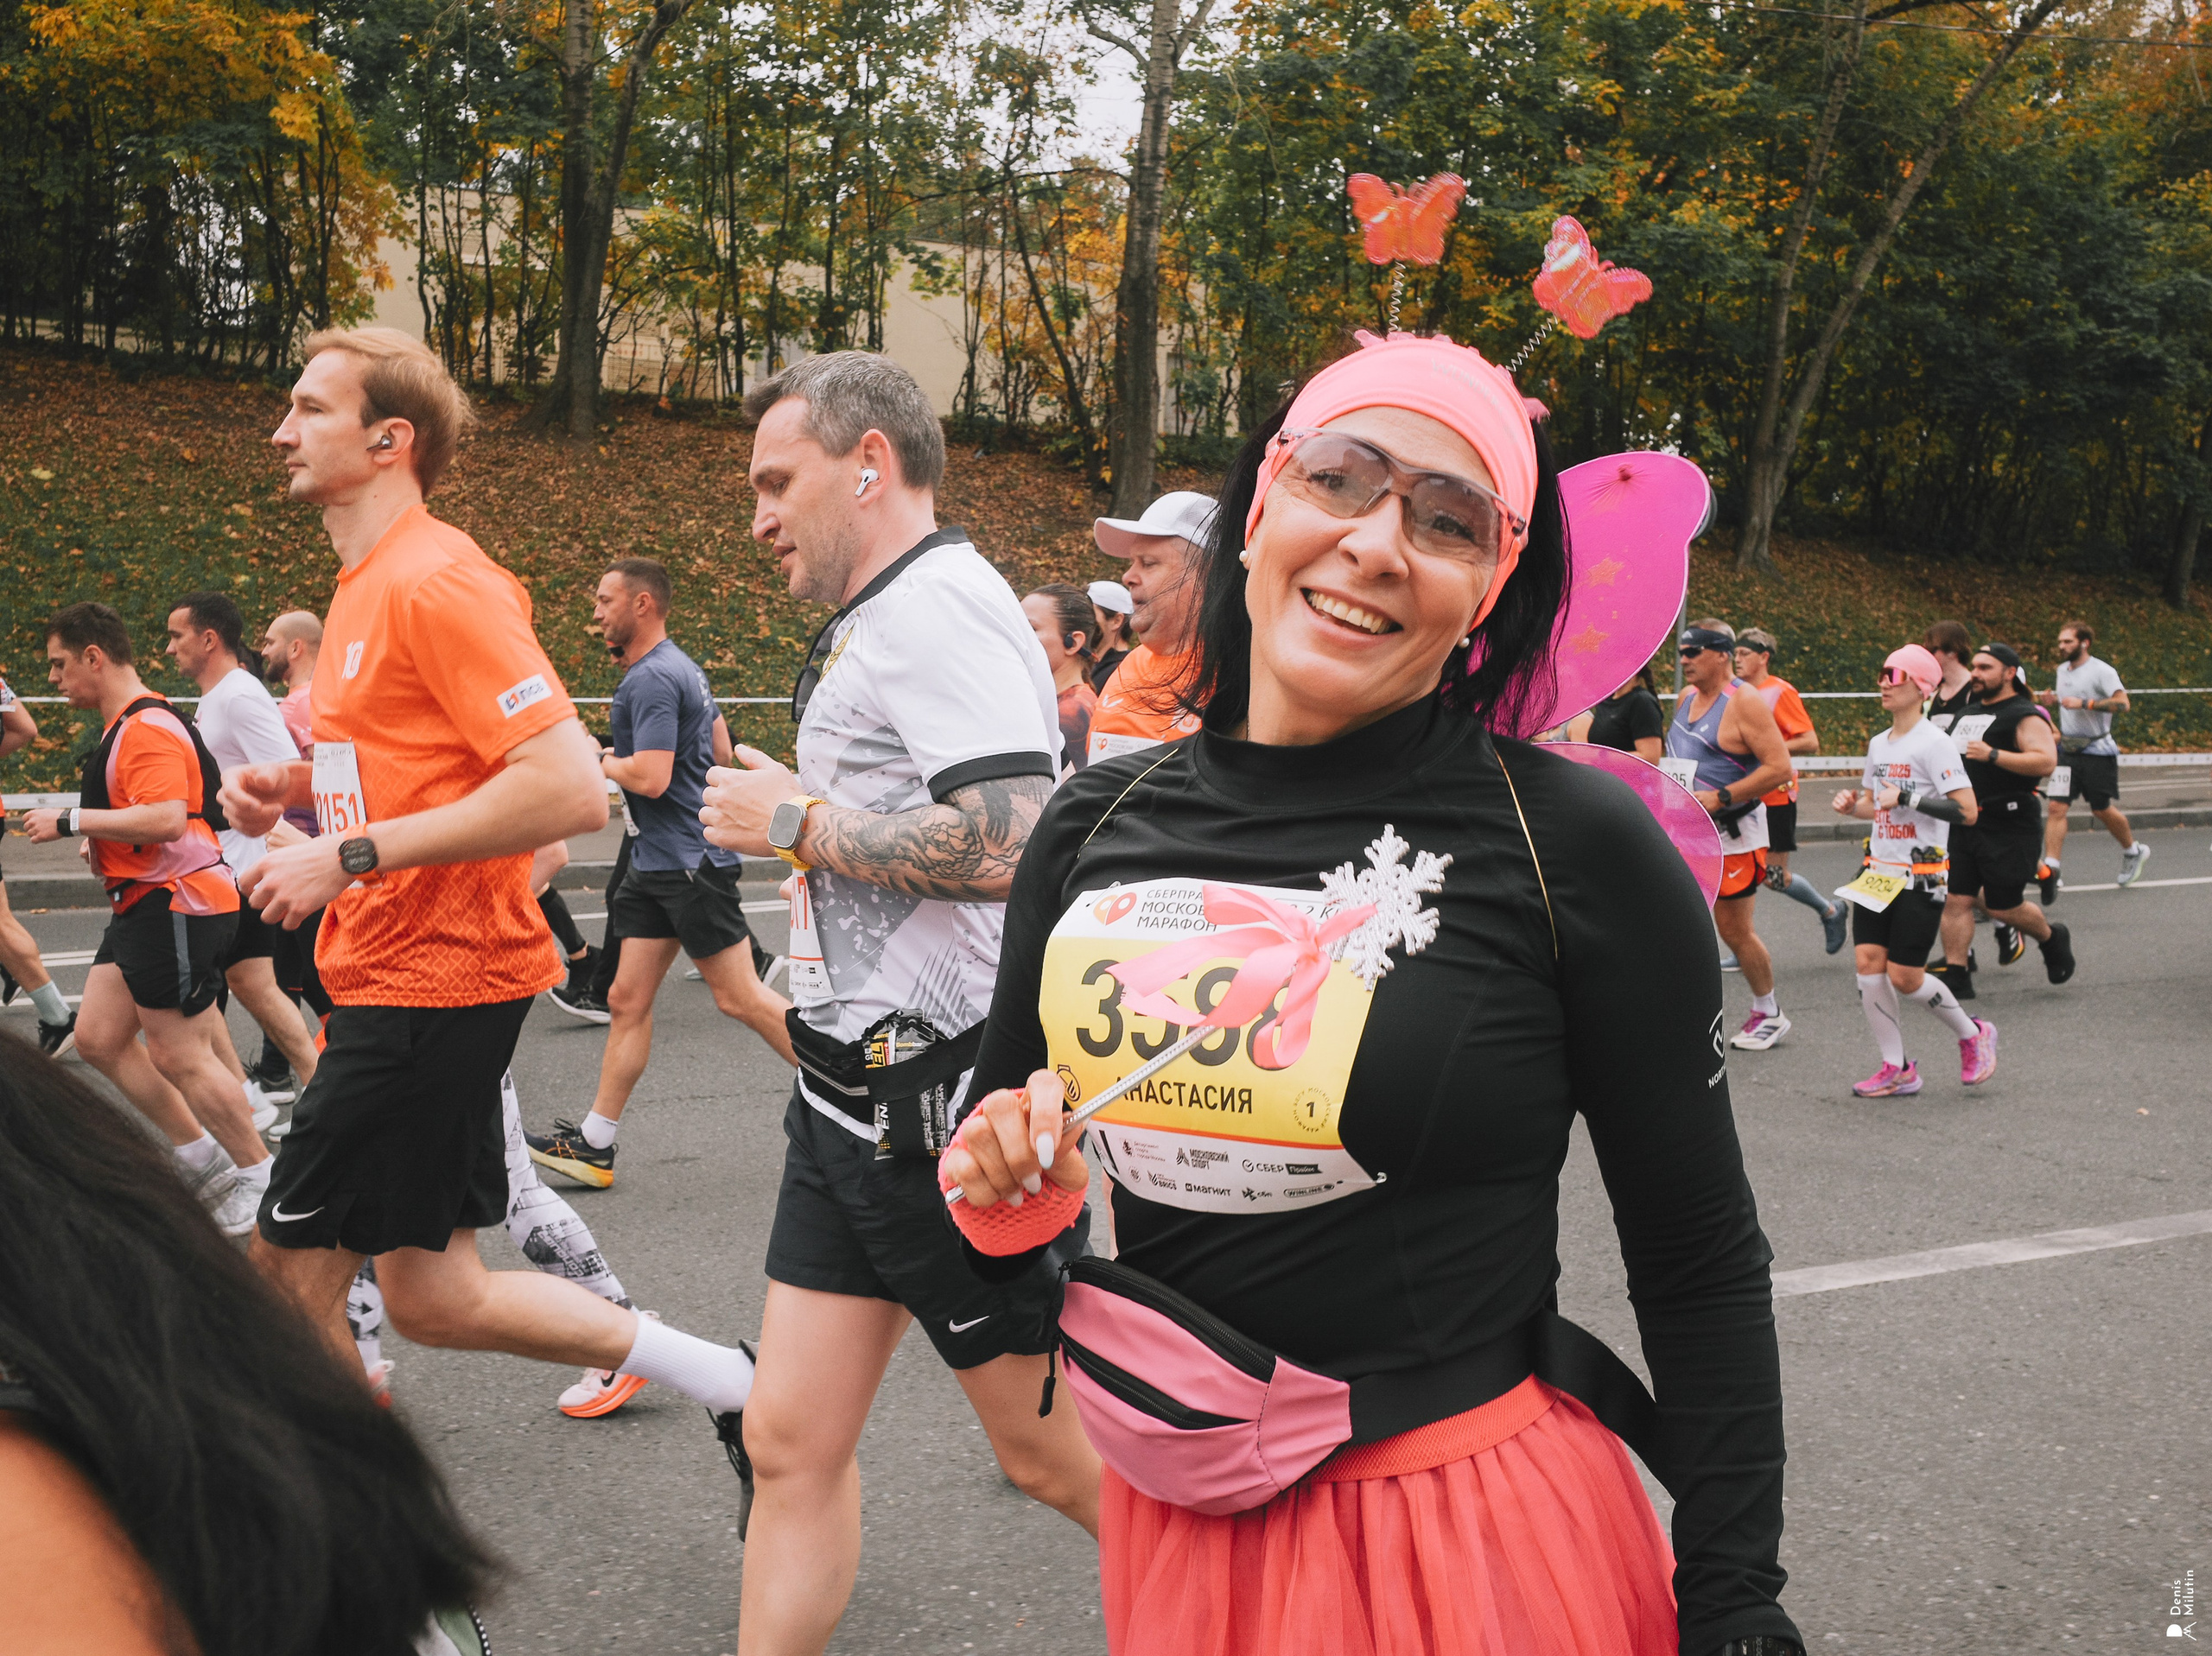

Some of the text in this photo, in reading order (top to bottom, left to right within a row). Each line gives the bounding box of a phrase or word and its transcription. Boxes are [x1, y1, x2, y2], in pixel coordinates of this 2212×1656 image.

[1147, 889, 1203, 900] СБЕРПРА
[1141, 901, 1205, 916] МОСКОВ
[1136, 916, 1217, 932] МАРАФОН
[1306, 1101, 1315, 1118] 1
[1255, 1163, 1284, 1173] СБЕР
